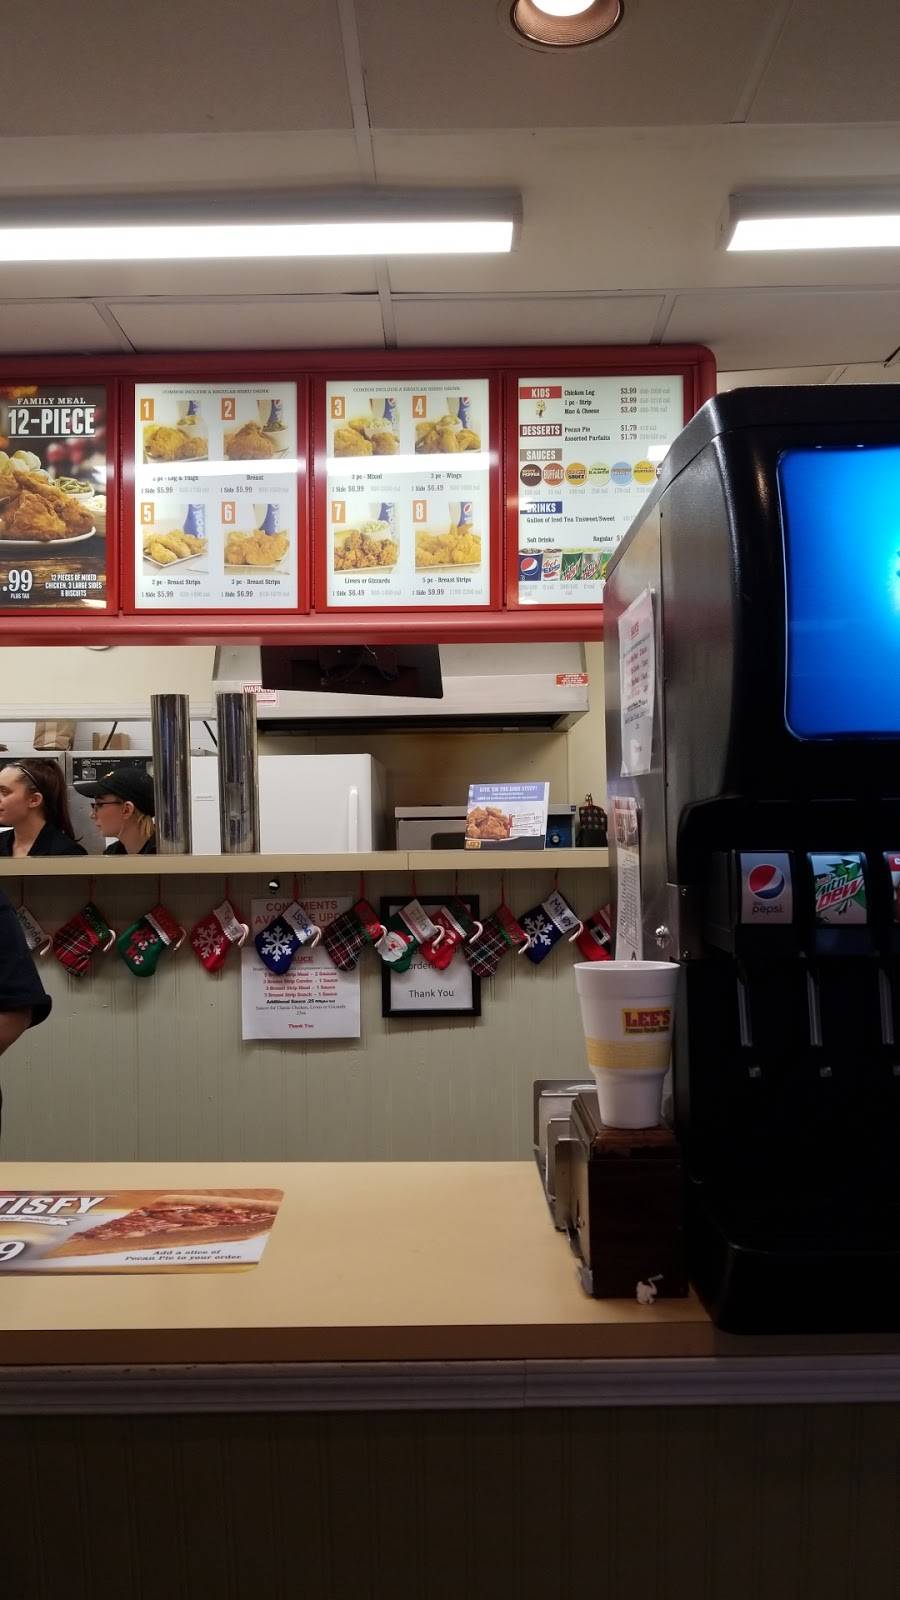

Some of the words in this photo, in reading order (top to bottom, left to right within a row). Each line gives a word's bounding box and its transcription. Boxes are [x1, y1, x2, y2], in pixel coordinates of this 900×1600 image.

[531, 388, 550, 398] KIDS
[144, 402, 150, 418] 1
[224, 400, 232, 418] 2
[334, 399, 342, 416] 3
[416, 398, 424, 416] 4
[8, 408, 95, 435] 12-PIECE
[522, 425, 560, 436] DESSERTS
[526, 450, 556, 460] SAUCES
[144, 504, 152, 522] 5
[224, 504, 232, 521] 6
[335, 504, 342, 520] 7
[416, 502, 424, 520] 8
[2, 570, 33, 592] .99
[266, 900, 338, 912] CONMENTS
[752, 904, 784, 915] pepsi
[409, 990, 436, 998] Thank
[624, 1009, 671, 1027] LEE'S
